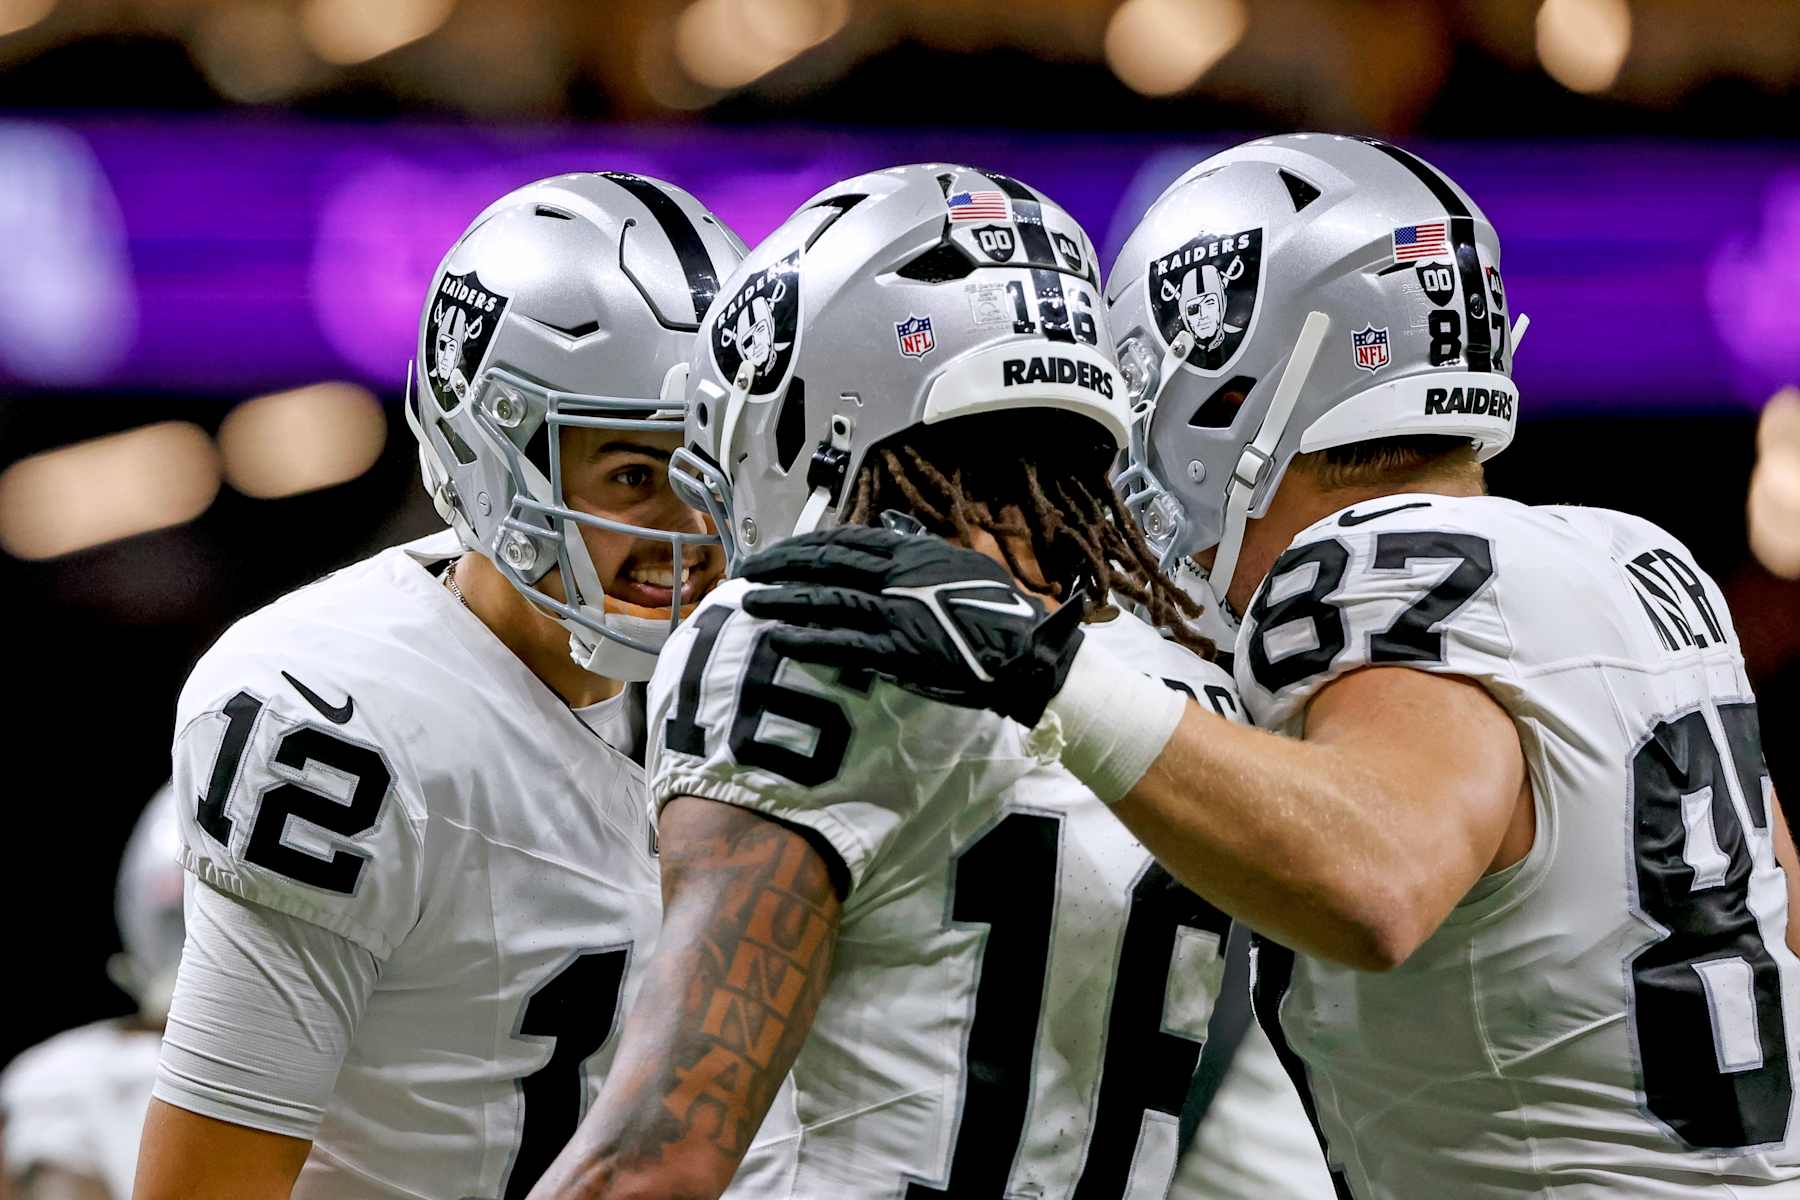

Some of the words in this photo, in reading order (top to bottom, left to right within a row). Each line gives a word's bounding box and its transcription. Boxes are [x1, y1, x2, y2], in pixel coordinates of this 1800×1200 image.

[1060, 239, 1081, 260] AL
[1157, 234, 1250, 276] RAIDERS
[441, 276, 498, 313] RAIDERS
[717, 257, 799, 330] RAIDE
[903, 333, 932, 353] NFL
[1359, 345, 1386, 366] NFL
[1003, 357, 1113, 400] RAIDERS
[1425, 387, 1513, 422] RAIDERS
[1248, 530, 1495, 695] 87
[665, 603, 873, 788] 16
[198, 690, 394, 896] 12
